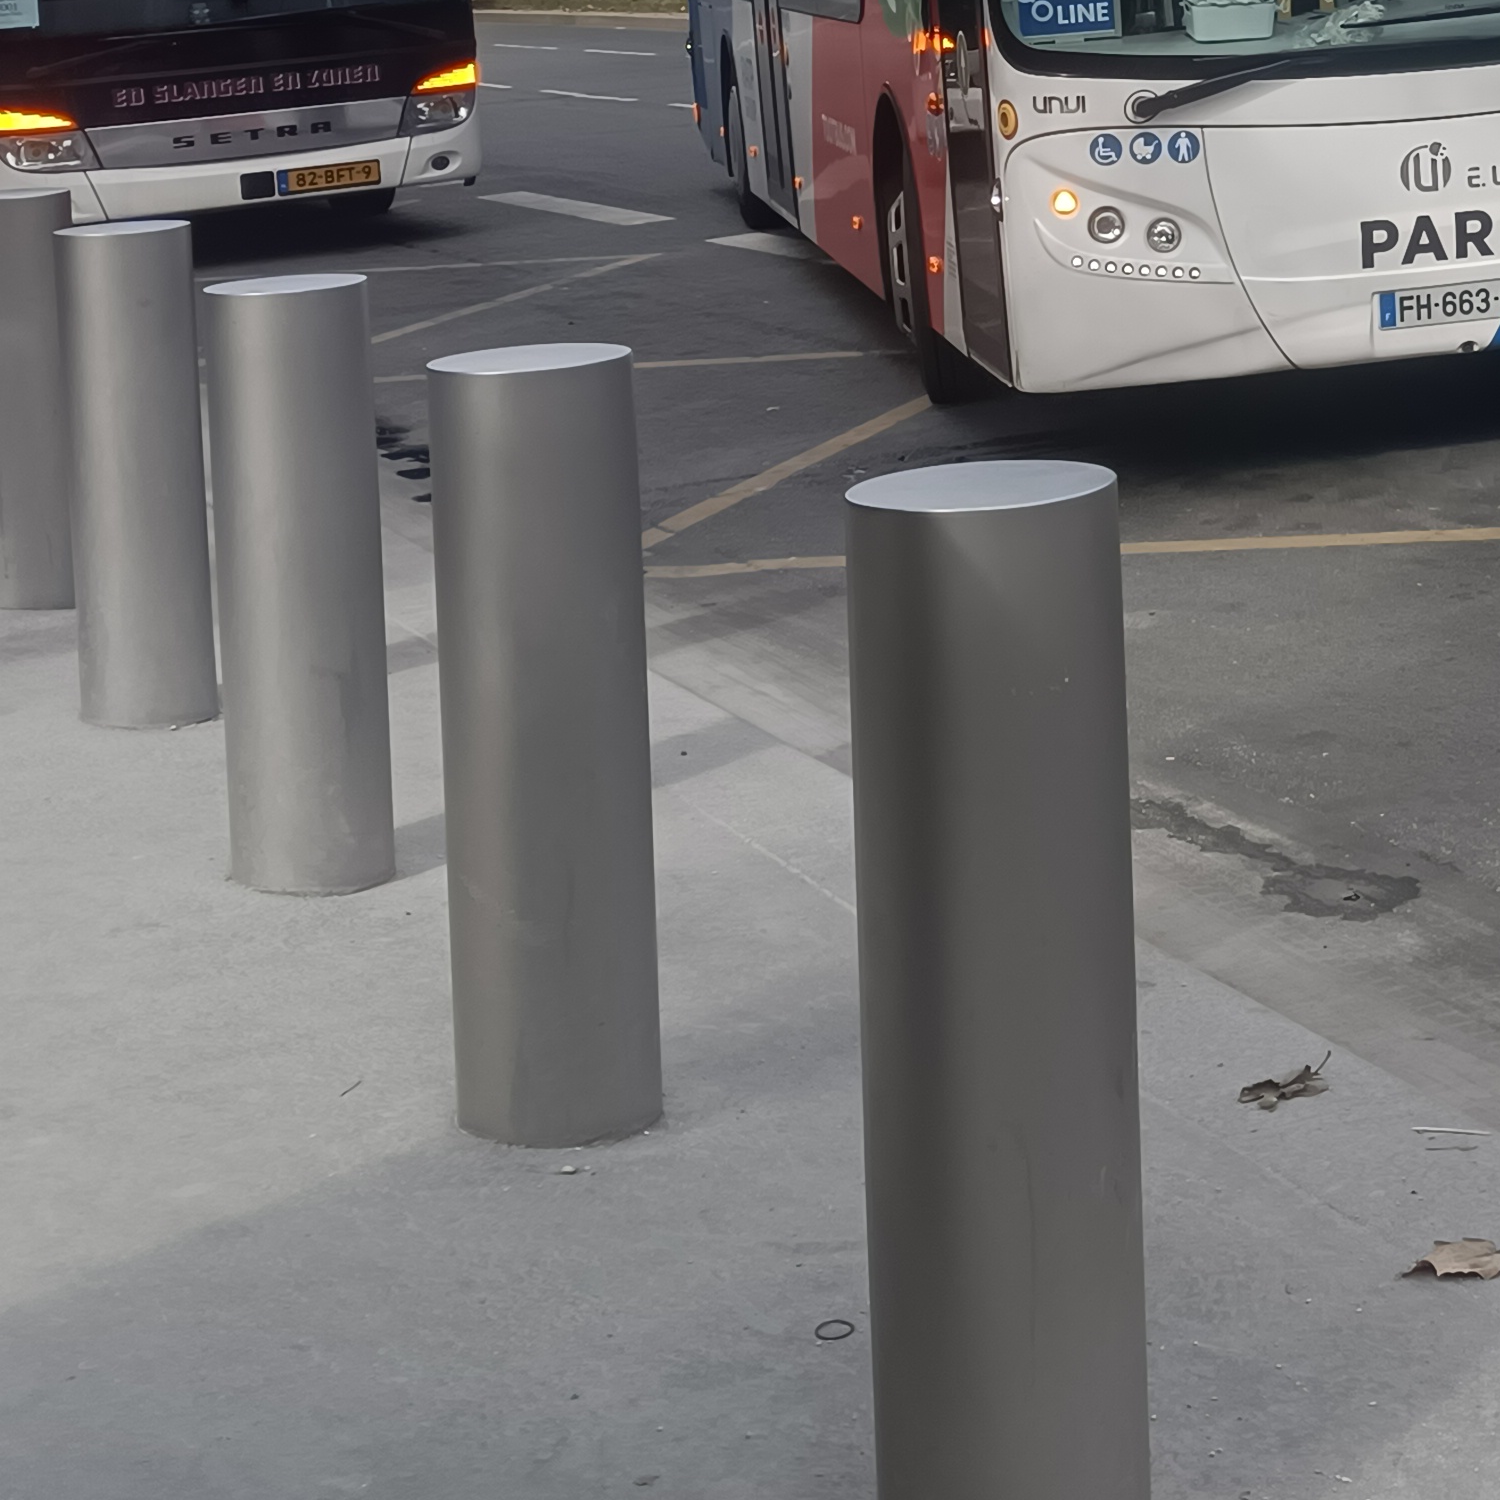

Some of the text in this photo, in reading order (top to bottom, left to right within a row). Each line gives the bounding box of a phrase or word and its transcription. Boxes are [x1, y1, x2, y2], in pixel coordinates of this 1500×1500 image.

[1056, 1, 1110, 25] LINE
[152, 75, 264, 104] SLANGEN
[270, 71, 301, 92] EN
[172, 121, 332, 149] SETRA
[295, 164, 373, 188] 82-BFT-9
